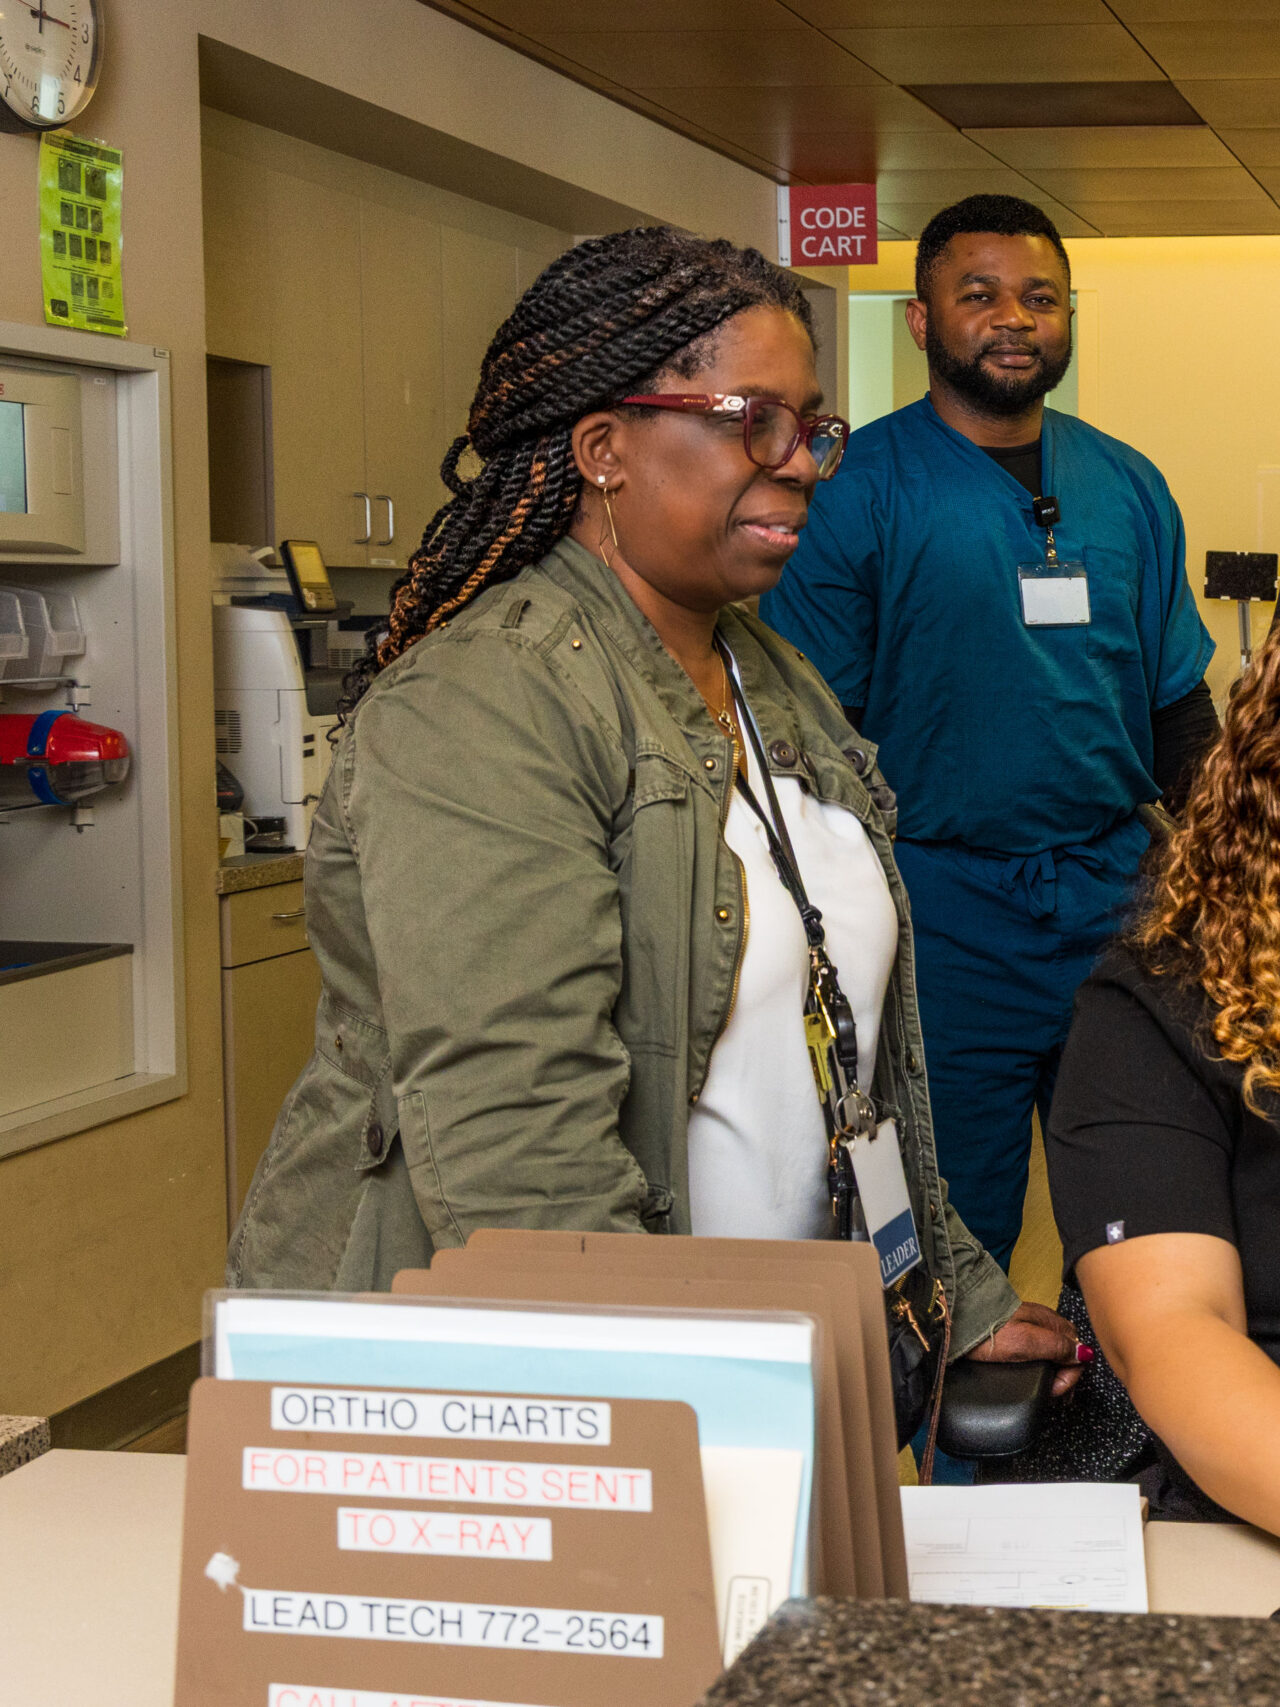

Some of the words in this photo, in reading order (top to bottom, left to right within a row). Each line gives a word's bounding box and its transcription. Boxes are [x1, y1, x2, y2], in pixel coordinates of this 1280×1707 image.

[81, 23, 90, 45] 3
[73, 64, 82, 88] 4
[31, 96, 40, 116] 6
[57, 92, 66, 115] 5
[800, 206, 866, 230] CODE
[800, 235, 867, 258] CART
[880, 1237, 918, 1278] LEADER
[282, 1393, 417, 1430] ORTHO
[442, 1401, 599, 1439] CHARTS
[251, 1453, 327, 1487] FOR
[343, 1458, 527, 1499] PATIENTS
[541, 1469, 645, 1504] SENT
[344, 1513, 397, 1546] TO
[411, 1516, 534, 1553] X-RAY
[251, 1596, 348, 1631] LEAD
[361, 1602, 462, 1638] TECH
[478, 1610, 651, 1651] 772-2564
